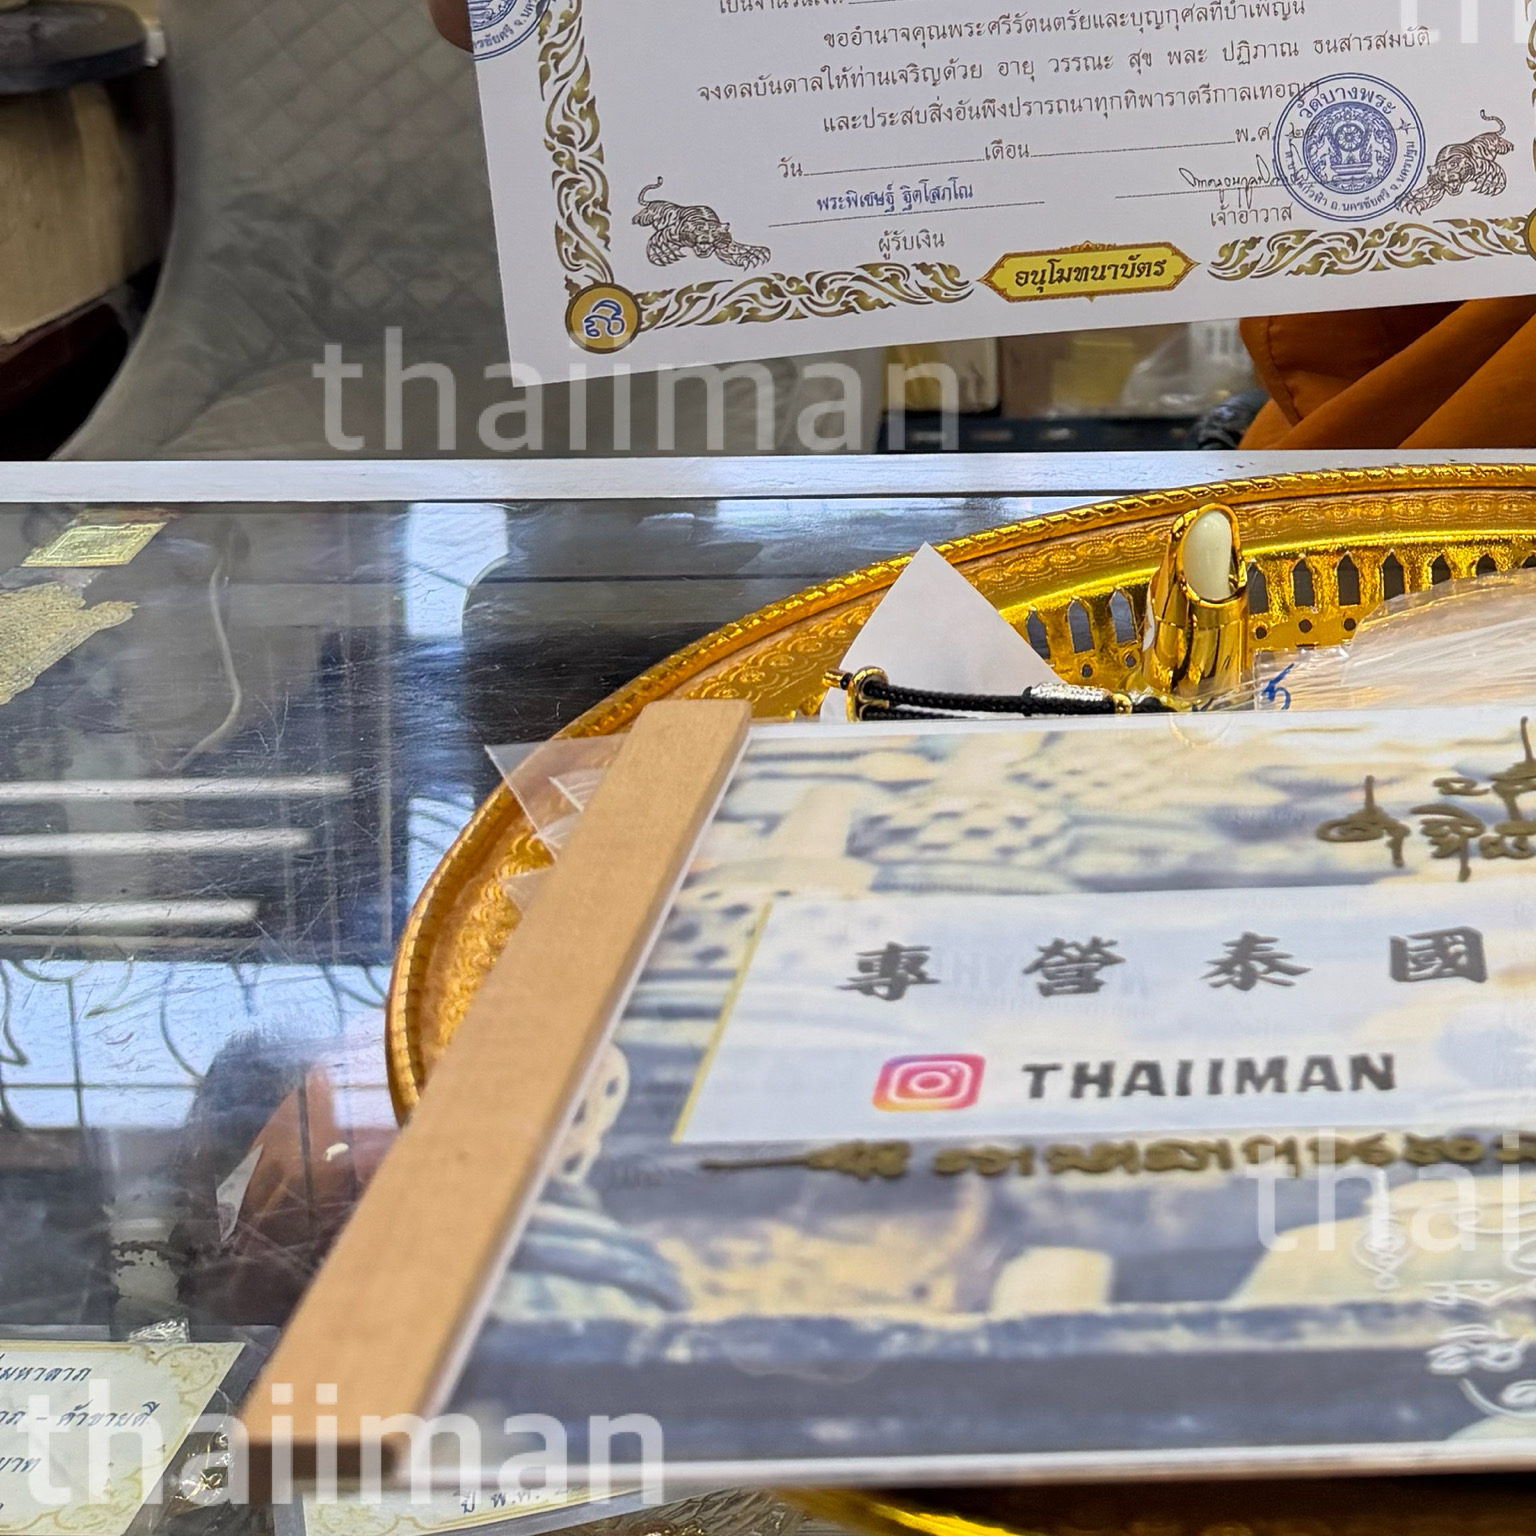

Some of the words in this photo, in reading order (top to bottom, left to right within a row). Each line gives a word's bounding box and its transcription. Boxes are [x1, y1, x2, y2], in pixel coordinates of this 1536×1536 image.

[997, 59, 1035, 84] อายุ
[1048, 54, 1114, 73] วรรณะ
[1128, 50, 1153, 78] สุข
[1167, 46, 1208, 66] พละ
[1222, 38, 1299, 66] ปฏิภาณ
[1313, 27, 1431, 54] ธนสารสมบัติ
[777, 155, 803, 179] วัน
[984, 138, 1030, 161] เดือน
[1210, 202, 1293, 227] เจ้าอาวาส
[878, 228, 946, 261] ผู้รับเงิน
[1015, 254, 1168, 293] อนุโมทนาบัตร
[1022, 1053, 1398, 1099] THAIIMAN
